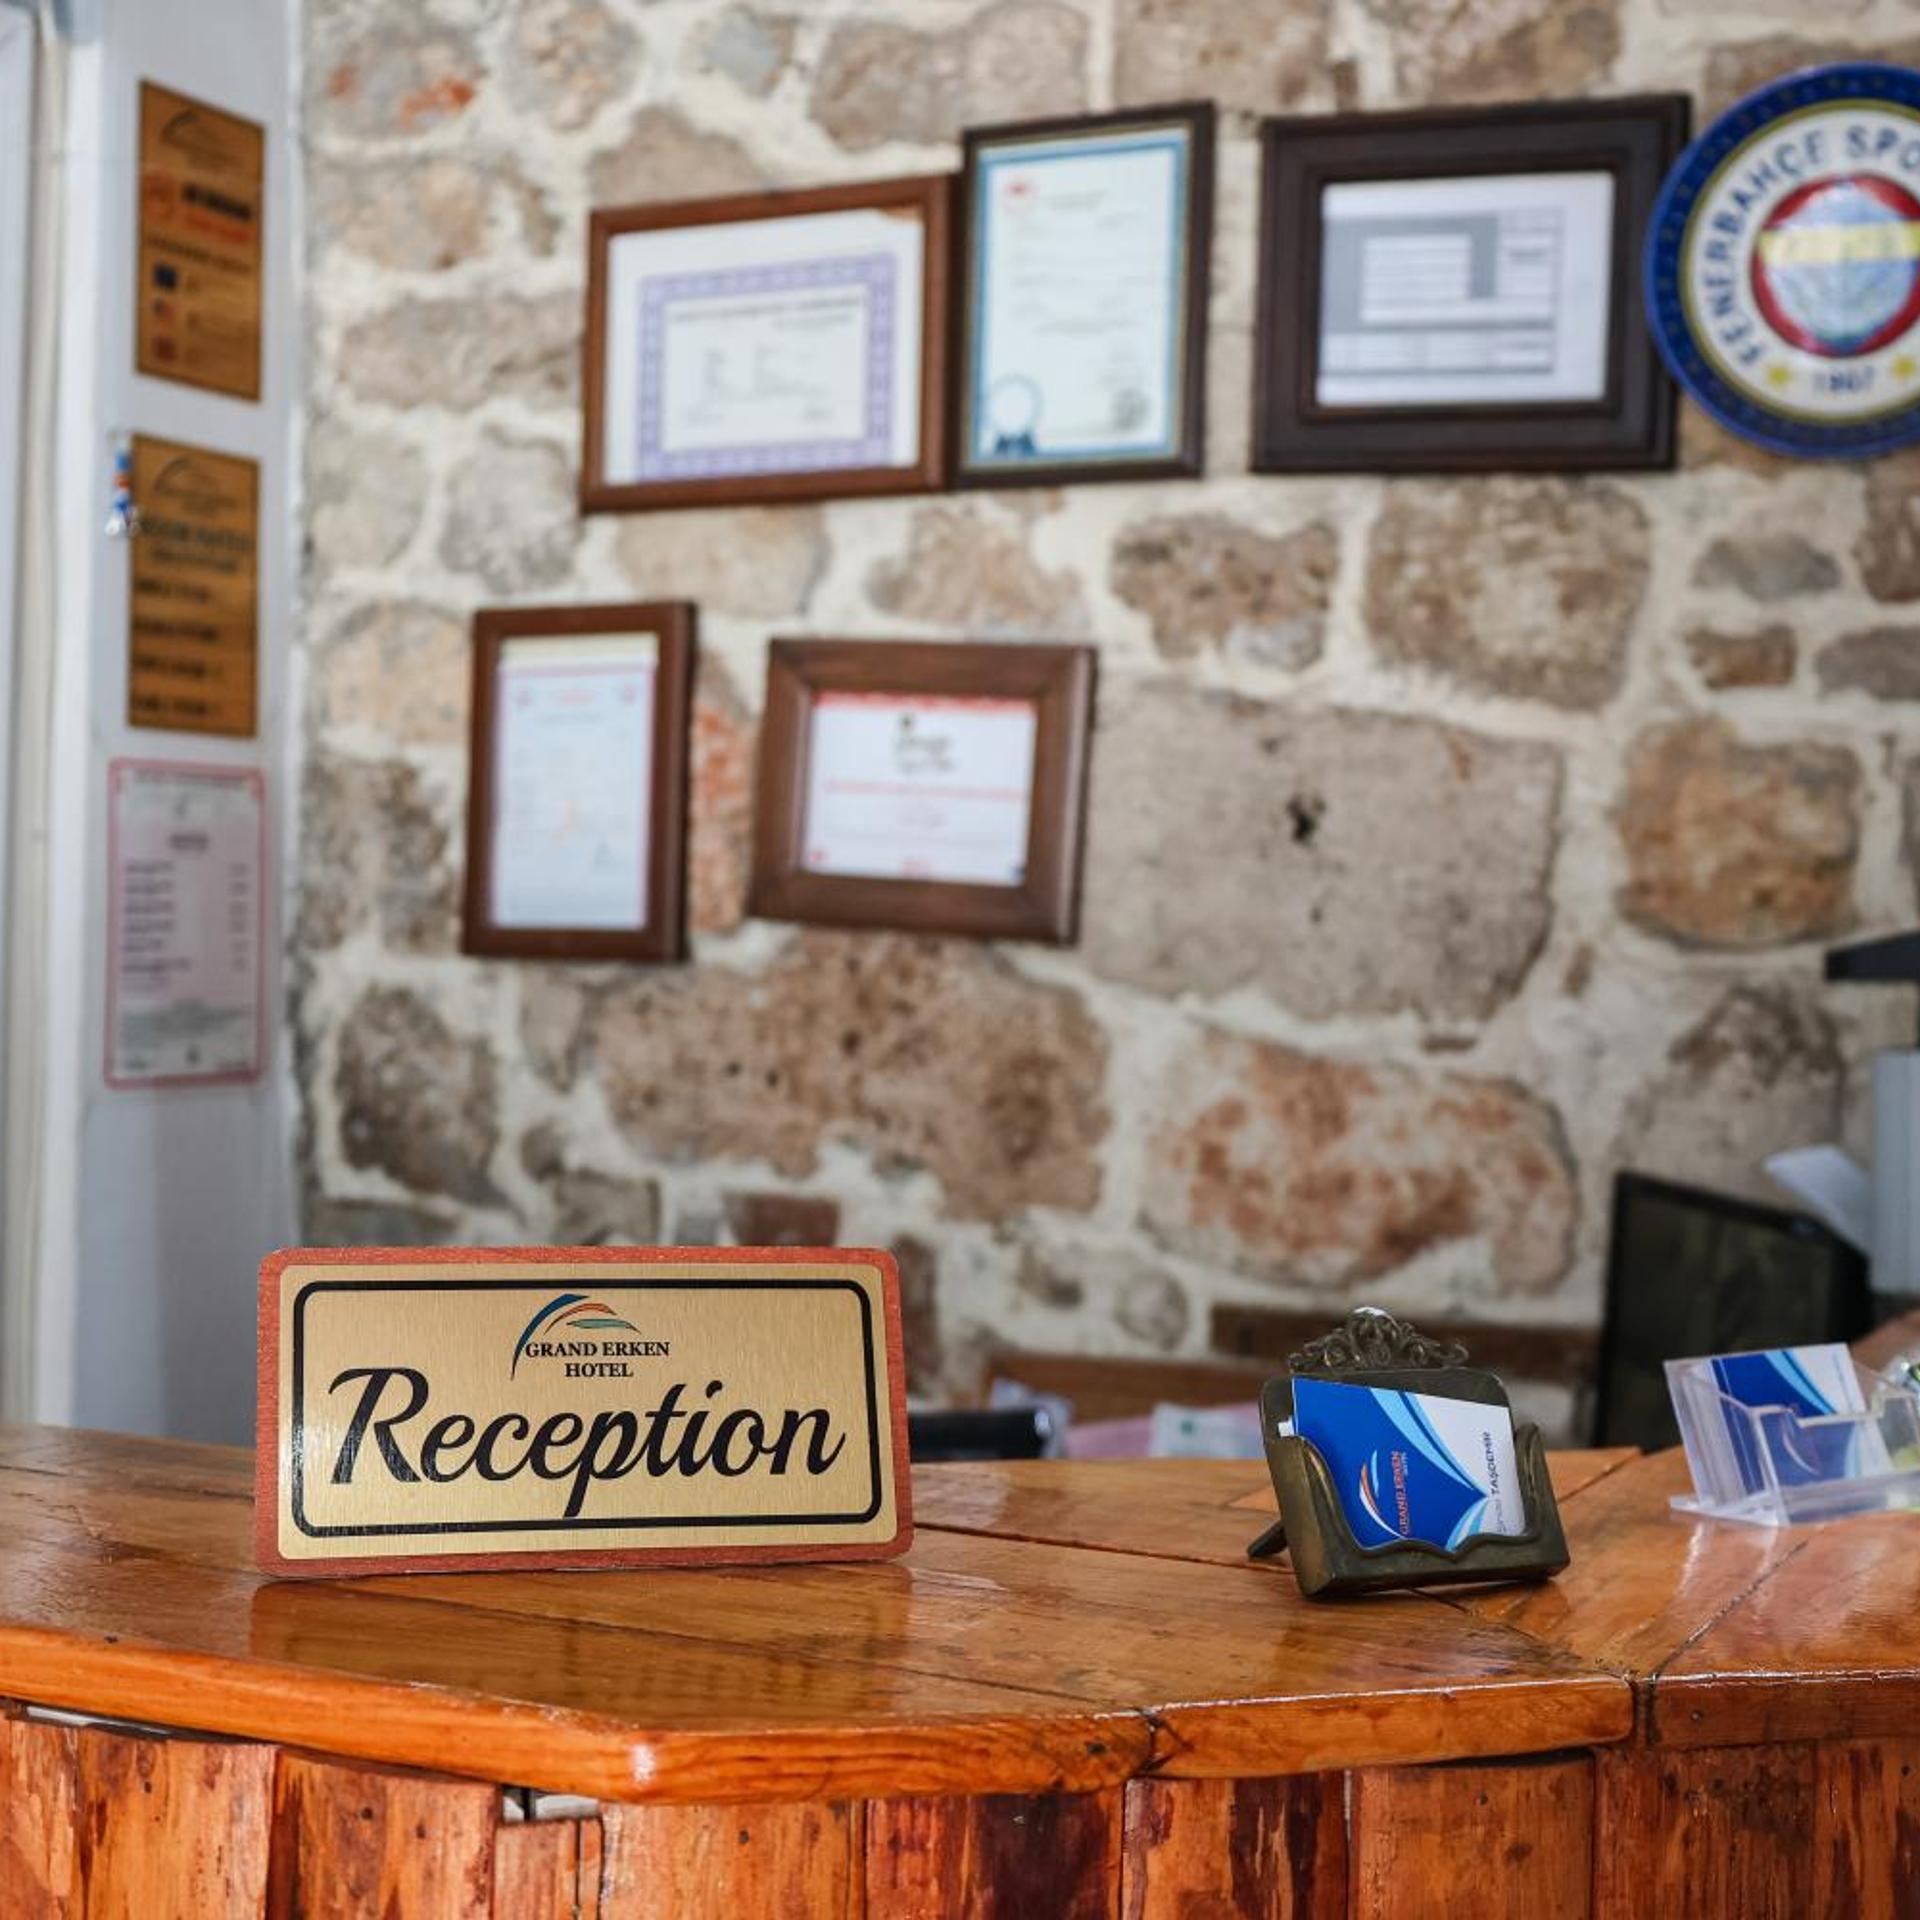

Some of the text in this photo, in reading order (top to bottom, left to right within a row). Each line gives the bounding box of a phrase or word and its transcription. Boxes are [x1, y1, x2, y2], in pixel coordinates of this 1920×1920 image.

[525, 1341, 670, 1358] GRAND ERKEN
[565, 1362, 634, 1377] HOTEL
[329, 1366, 846, 1518] Reception
